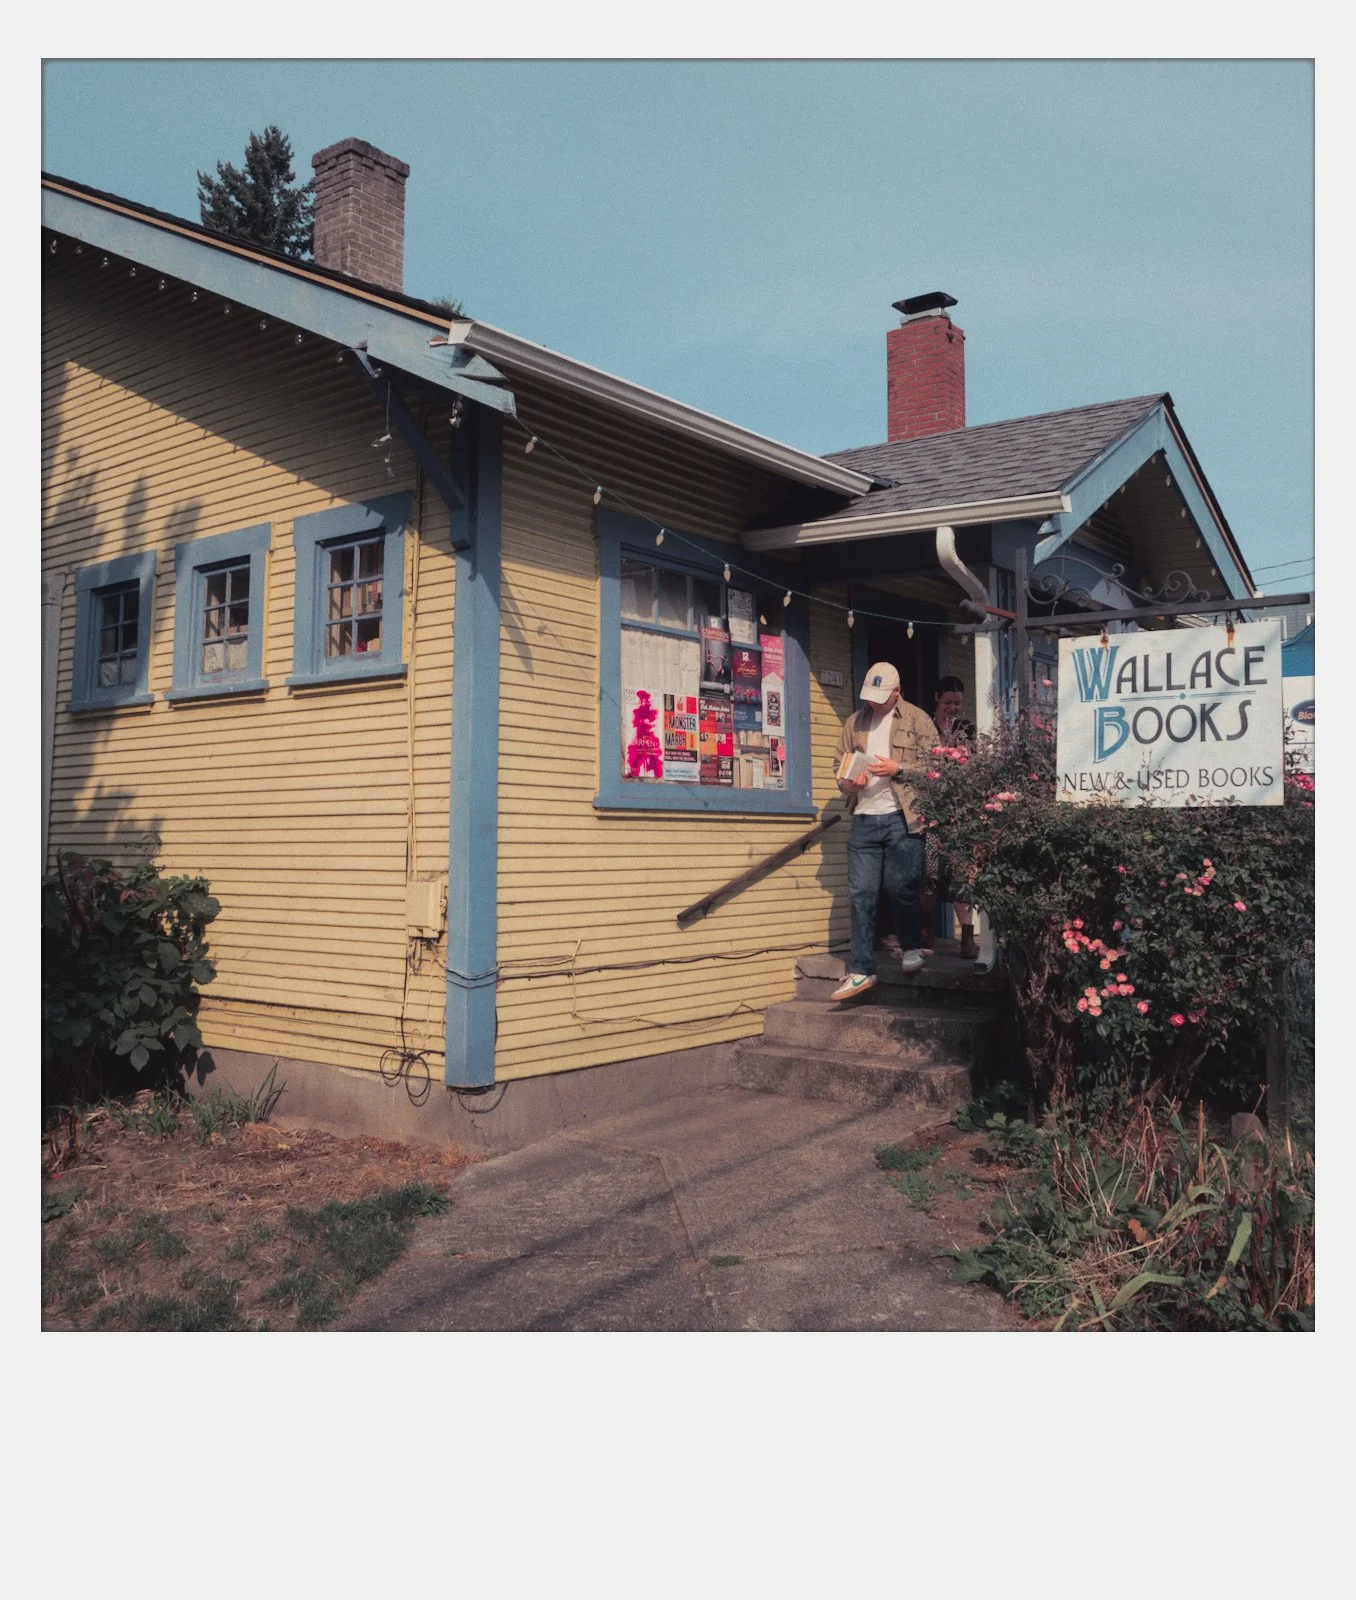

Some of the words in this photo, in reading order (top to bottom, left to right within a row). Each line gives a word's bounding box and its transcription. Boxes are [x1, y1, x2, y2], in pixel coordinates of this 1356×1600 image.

[1072, 645, 1268, 703] WALLACE
[667, 715, 697, 731] MONSTER
[1093, 699, 1252, 763] BOOKS
[635, 738, 656, 748] ARMEN
[1063, 771, 1108, 790] NEW
[1115, 771, 1130, 789] &
[1136, 769, 1189, 790] USED
[1198, 766, 1274, 788] BOOKS
